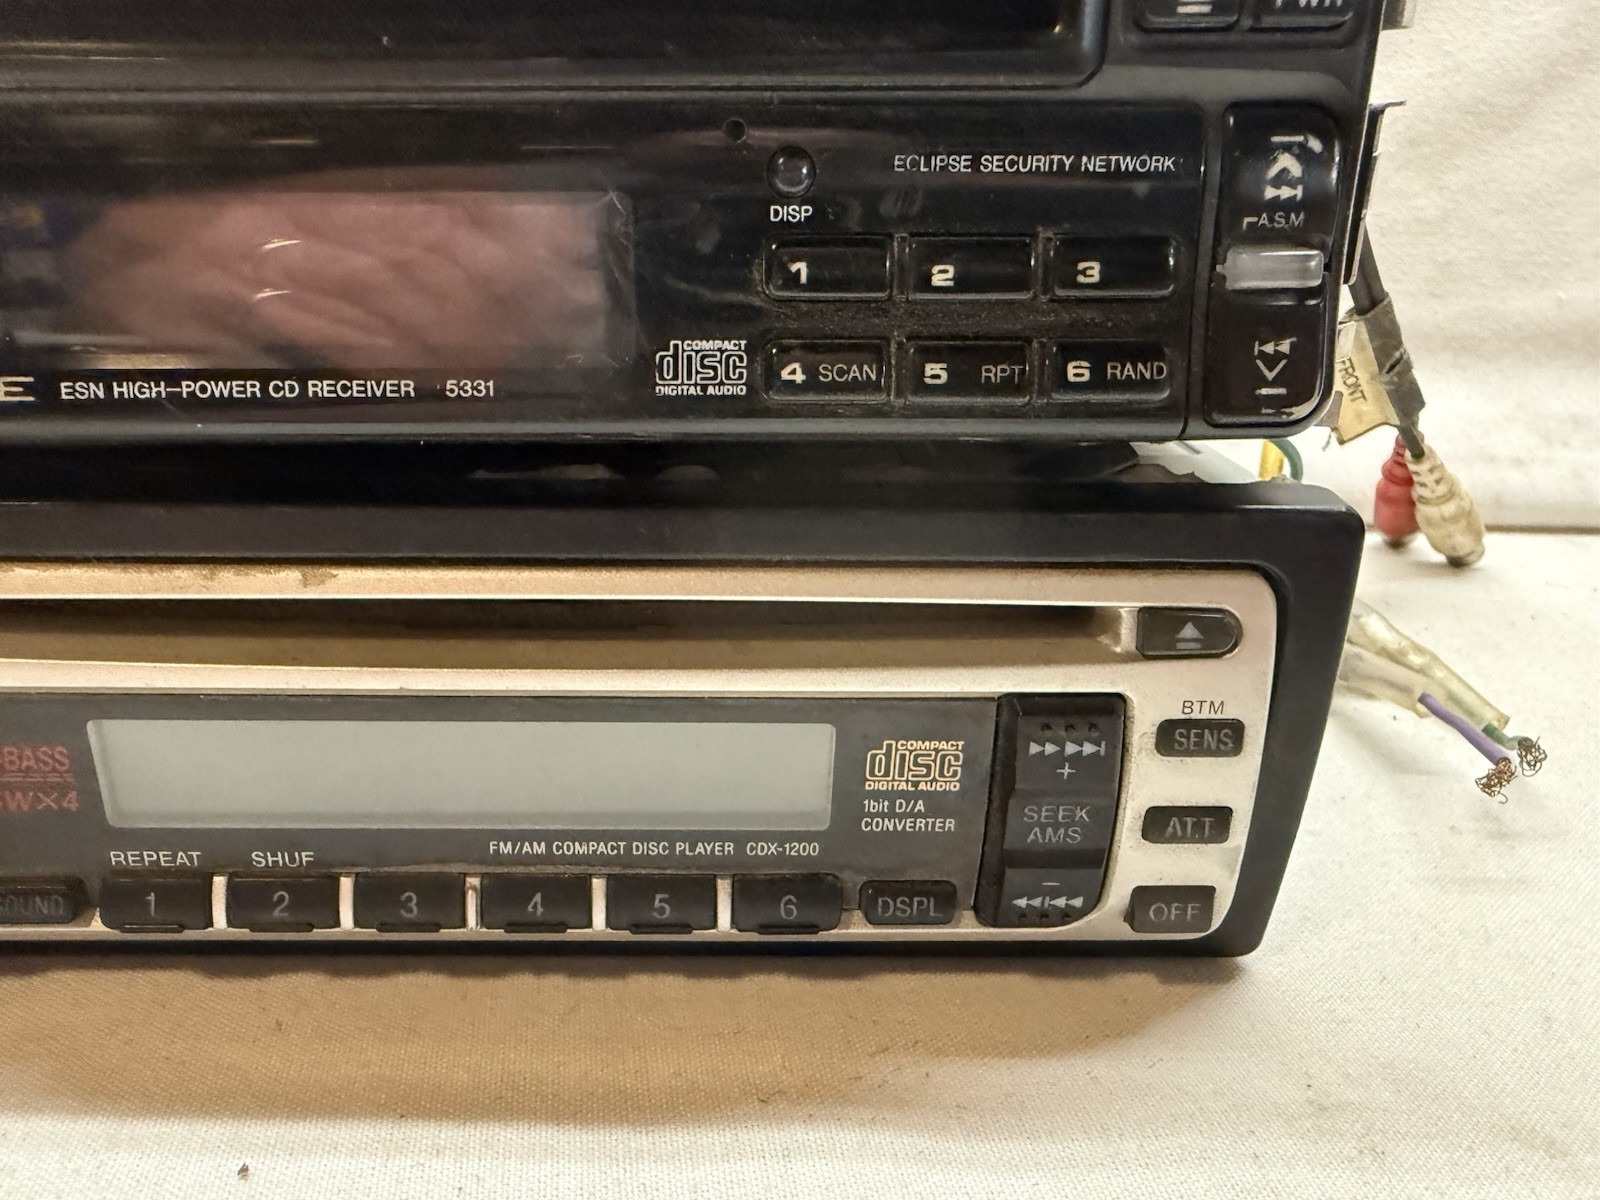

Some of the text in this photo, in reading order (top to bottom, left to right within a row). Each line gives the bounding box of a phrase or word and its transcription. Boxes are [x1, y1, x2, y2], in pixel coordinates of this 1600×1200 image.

[894, 154, 1177, 172] ECLIPSE SECURITY NETWORK
[769, 204, 813, 223] DISP
[789, 261, 809, 284] 1
[931, 264, 955, 287] 2
[1076, 261, 1101, 284] 3
[683, 340, 747, 350] COMPACT
[780, 362, 807, 384] 4
[818, 363, 877, 382] SCAN
[923, 362, 949, 385] 5
[981, 364, 1023, 384] RPT
[1066, 360, 1091, 383] 6
[1107, 361, 1167, 380] RAND
[60, 381, 104, 399] ESN
[268, 380, 299, 398] CD
[307, 379, 415, 398] RECEIVER
[445, 379, 495, 398] 5331
[655, 385, 747, 396] DIGITAL AUDIO
[1181, 700, 1225, 715] BTM
[897, 740, 965, 750] COMPACT
[1174, 728, 1234, 751] SENS
[865, 781, 961, 791] DIGITAL AUDIO
[863, 798, 925, 813] 1bit D/A
[1023, 805, 1090, 822] SEEK
[861, 818, 955, 832] CONVERTER
[1026, 826, 1082, 845] AMS
[109, 850, 202, 867] REPEAT
[251, 850, 315, 868] SHUF
[489, 841, 820, 857] FM/AM COMPACT DISC PLAYER CDX-1200
[144, 891, 156, 918] 1
[271, 890, 290, 919] 2
[400, 891, 419, 919] 3
[525, 892, 545, 918] 4
[652, 893, 672, 919] 5
[779, 895, 798, 920] 6
[877, 896, 943, 918] DSPL
[1148, 902, 1201, 923] OFF
